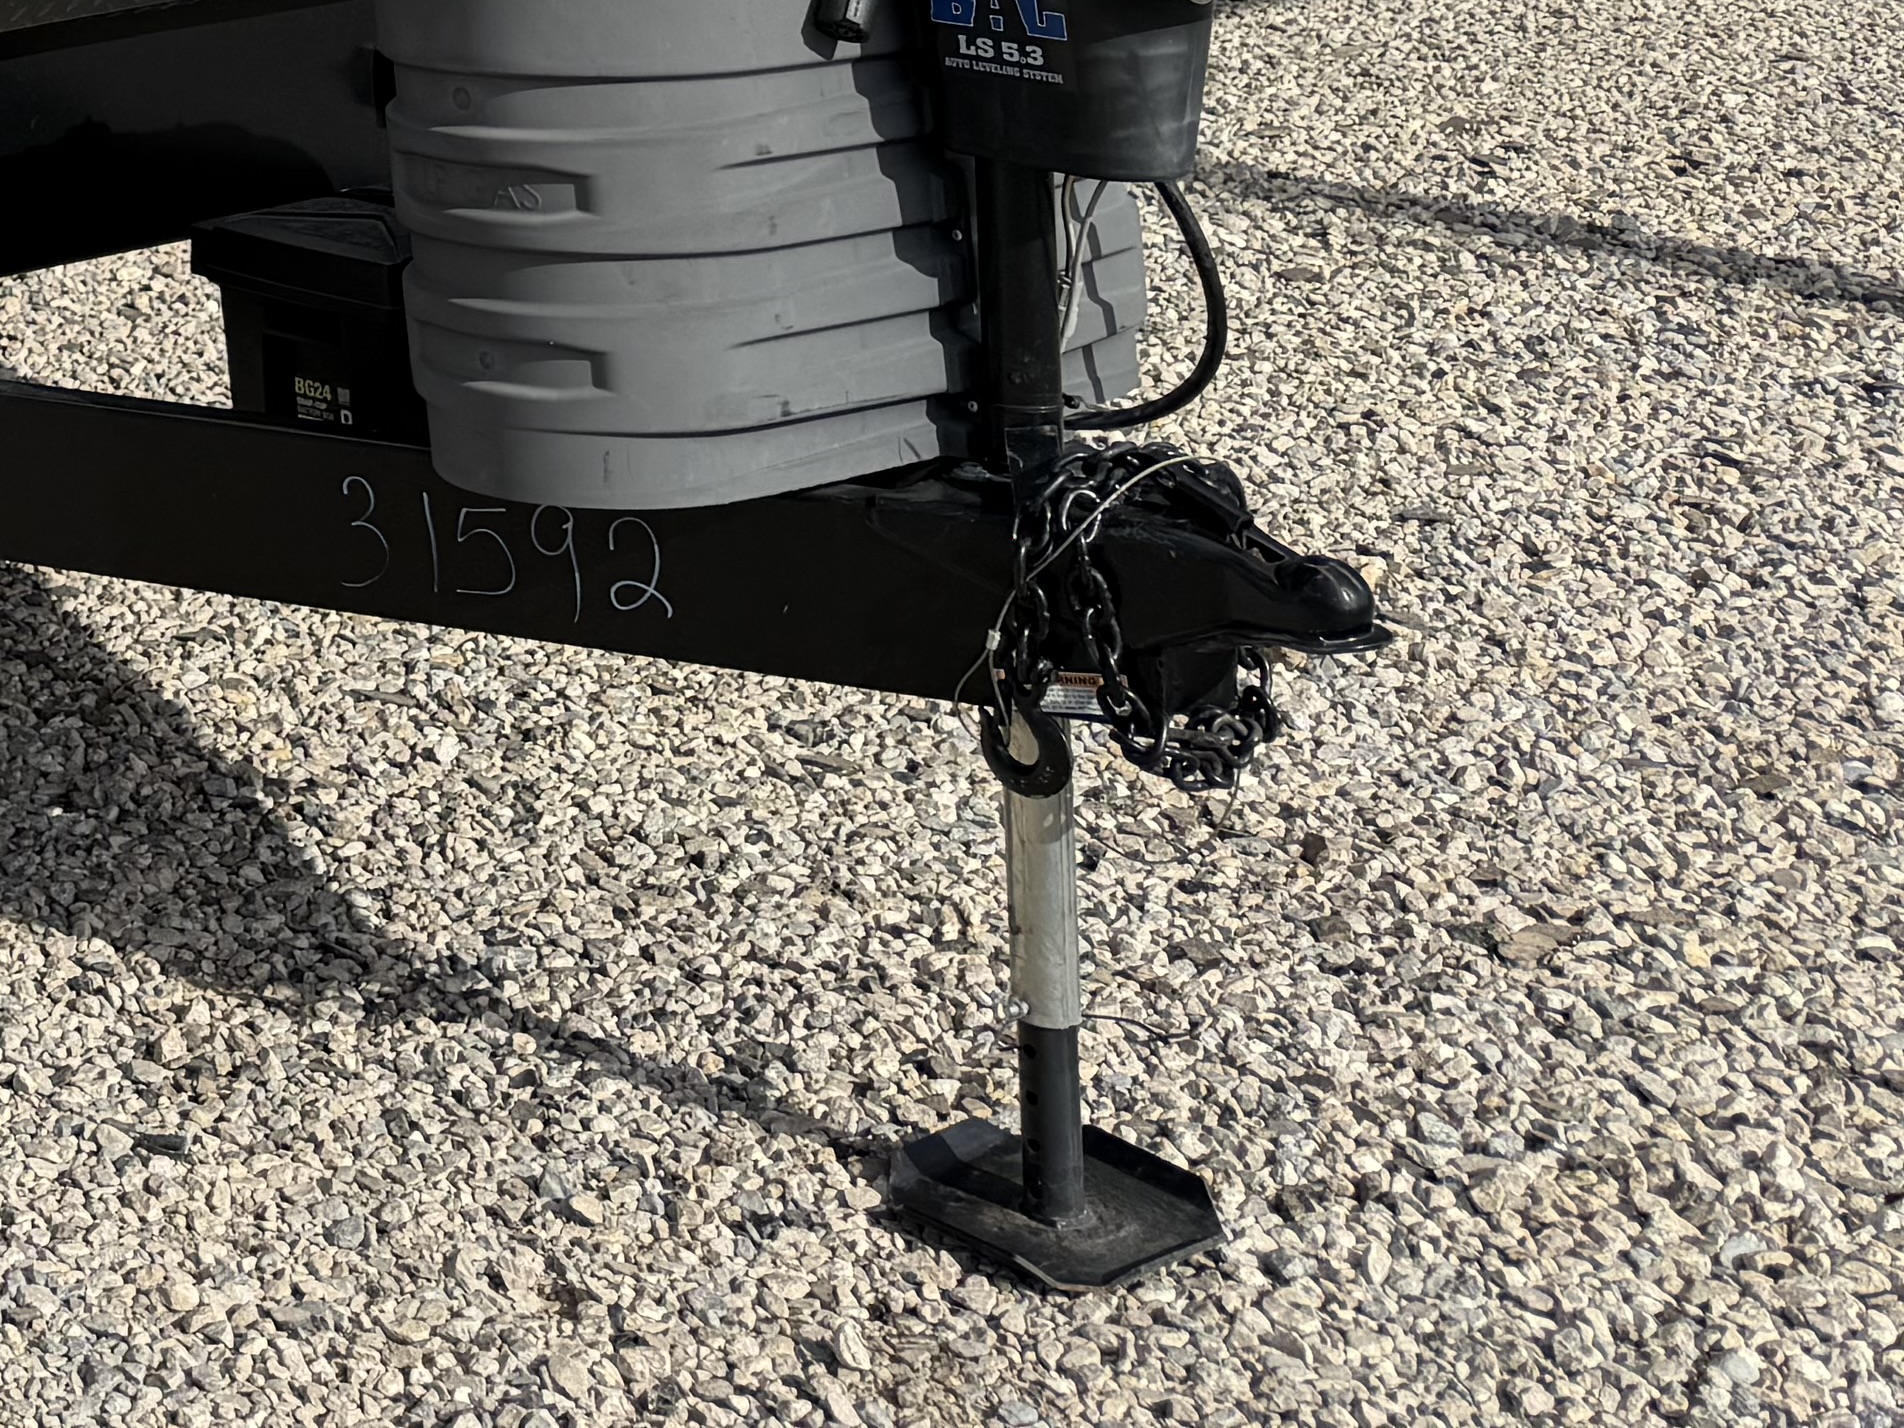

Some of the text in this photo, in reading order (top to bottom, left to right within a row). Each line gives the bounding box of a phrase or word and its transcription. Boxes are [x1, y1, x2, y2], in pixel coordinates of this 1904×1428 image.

[957, 34, 1045, 66] LS 5.3
[1022, 68, 1065, 85] SYSTEM
[294, 376, 332, 402] BG24
[341, 475, 673, 623] 31592
